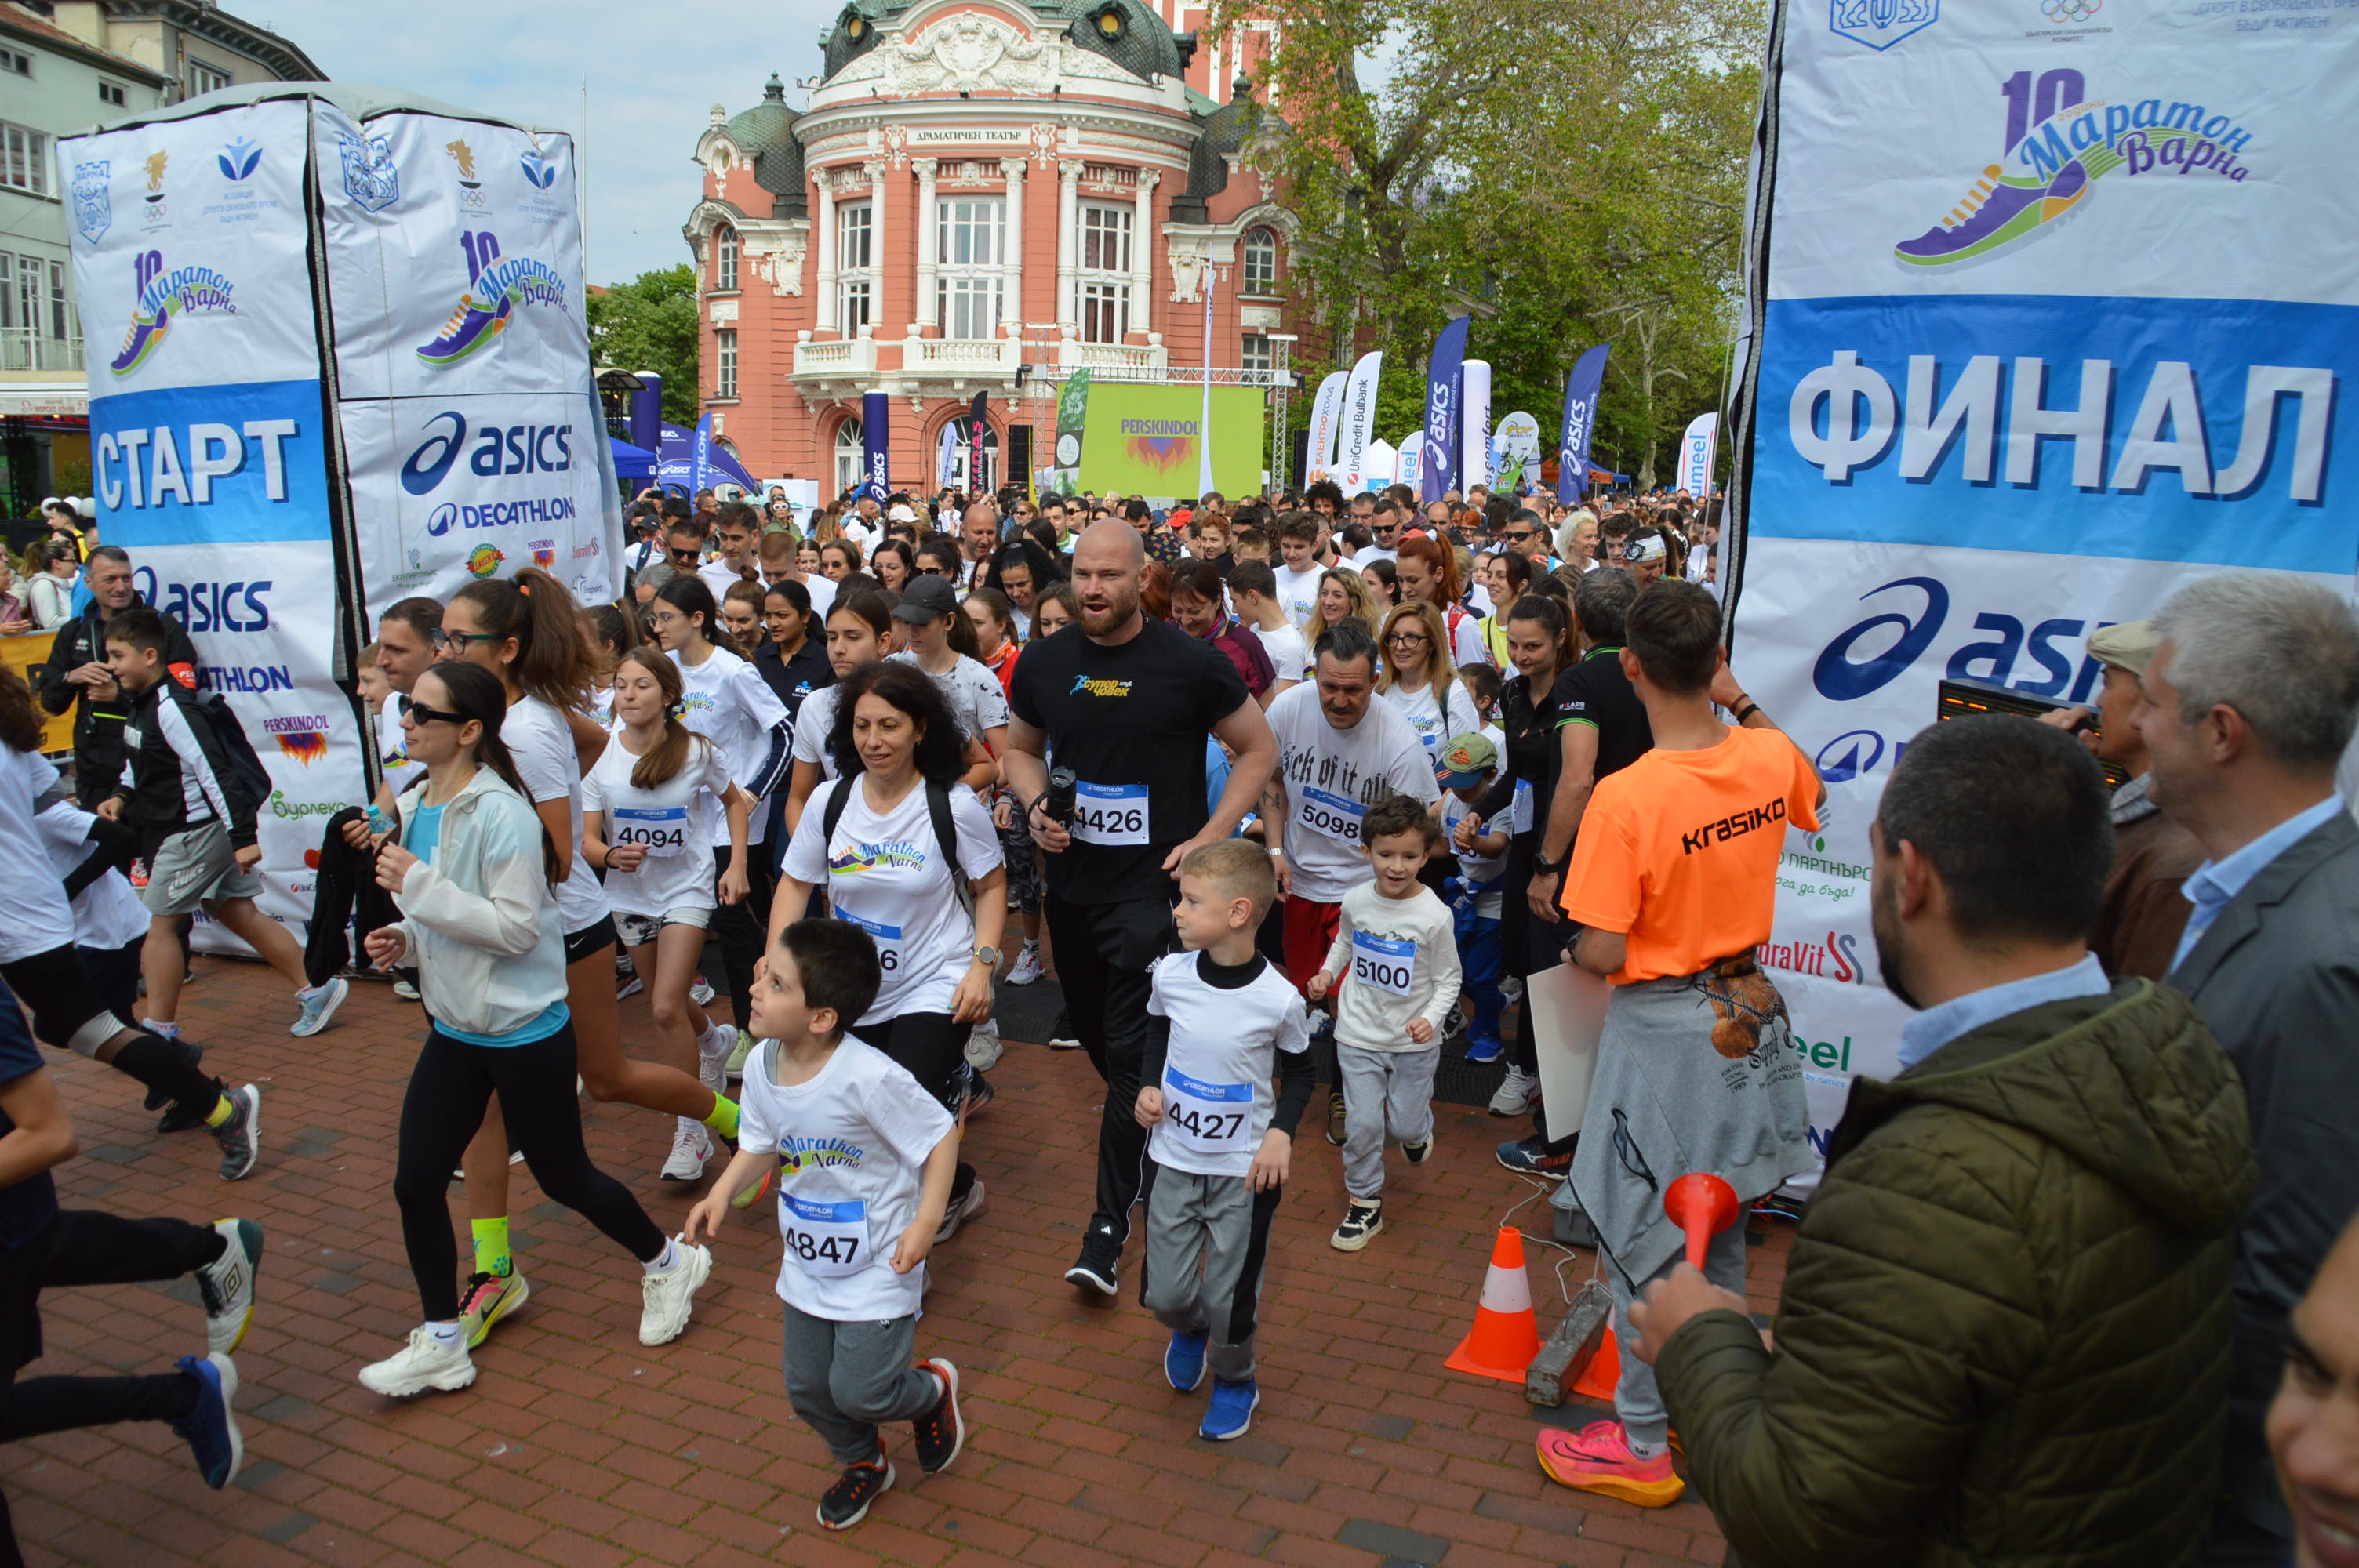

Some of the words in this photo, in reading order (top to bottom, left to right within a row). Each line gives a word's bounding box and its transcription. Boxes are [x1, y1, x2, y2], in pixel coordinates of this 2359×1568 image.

[2001, 68, 2085, 158] 10
[916, 131, 981, 140] ДРАМАТИЧЕН
[986, 131, 1022, 140] ТЕАТЪР
[2020, 99, 2252, 185] Маратон
[2117, 131, 2249, 183] Варна
[460, 230, 500, 289] 10
[134, 249, 162, 308] 10
[143, 266, 234, 315] Маратон
[479, 256, 566, 309] Маратон
[519, 277, 569, 313] Варна
[179, 285, 237, 314] Варна
[1354, 379, 1369, 422] Bulbank
[1430, 381, 1449, 441] asics
[1121, 419, 1198, 435] PERSKINDOL
[1567, 398, 1586, 452] asics
[1789, 350, 2336, 503] ФИНАЛ
[97, 419, 297, 510] СТАРТ
[471, 424, 572, 477] asics
[697, 430, 707, 491] ATHLON
[1350, 424, 1364, 472] UniCredit
[874, 452, 885, 487] asics
[1688, 434, 1707, 501] umeel
[461, 497, 576, 529] DECATHLON
[165, 580, 273, 633] asics
[1946, 612, 2119, 702] asi
[196, 664, 294, 694] ATHLON
[683, 690, 715, 706] arathon
[264, 716, 329, 733] PERSKINDOL
[1318, 754, 1339, 793] of
[1342, 759, 1358, 796] it
[1075, 805, 1143, 833] 4426
[1302, 804, 1359, 839] 5098
[618, 827, 685, 848] 4094
[859, 840, 927, 864] Marathon
[885, 853, 924, 872] Varna
[1775, 877, 1796, 890] ога
[1797, 883, 1816, 897] да
[1819, 884, 1856, 902] бъда!
[1356, 956, 1410, 989] 5100
[1757, 941, 1825, 977] praVit
[1190, 1082, 1226, 1094] DECATHLON
[1730, 1082, 1747, 1093] 1989
[1805, 1073, 1815, 1083] by
[1817, 1076, 1846, 1088] nature
[1168, 1102, 1245, 1139] 4427
[780, 1134, 863, 1160] Marathon
[811, 1151, 860, 1169] Varna
[786, 1226, 859, 1264] 4847
